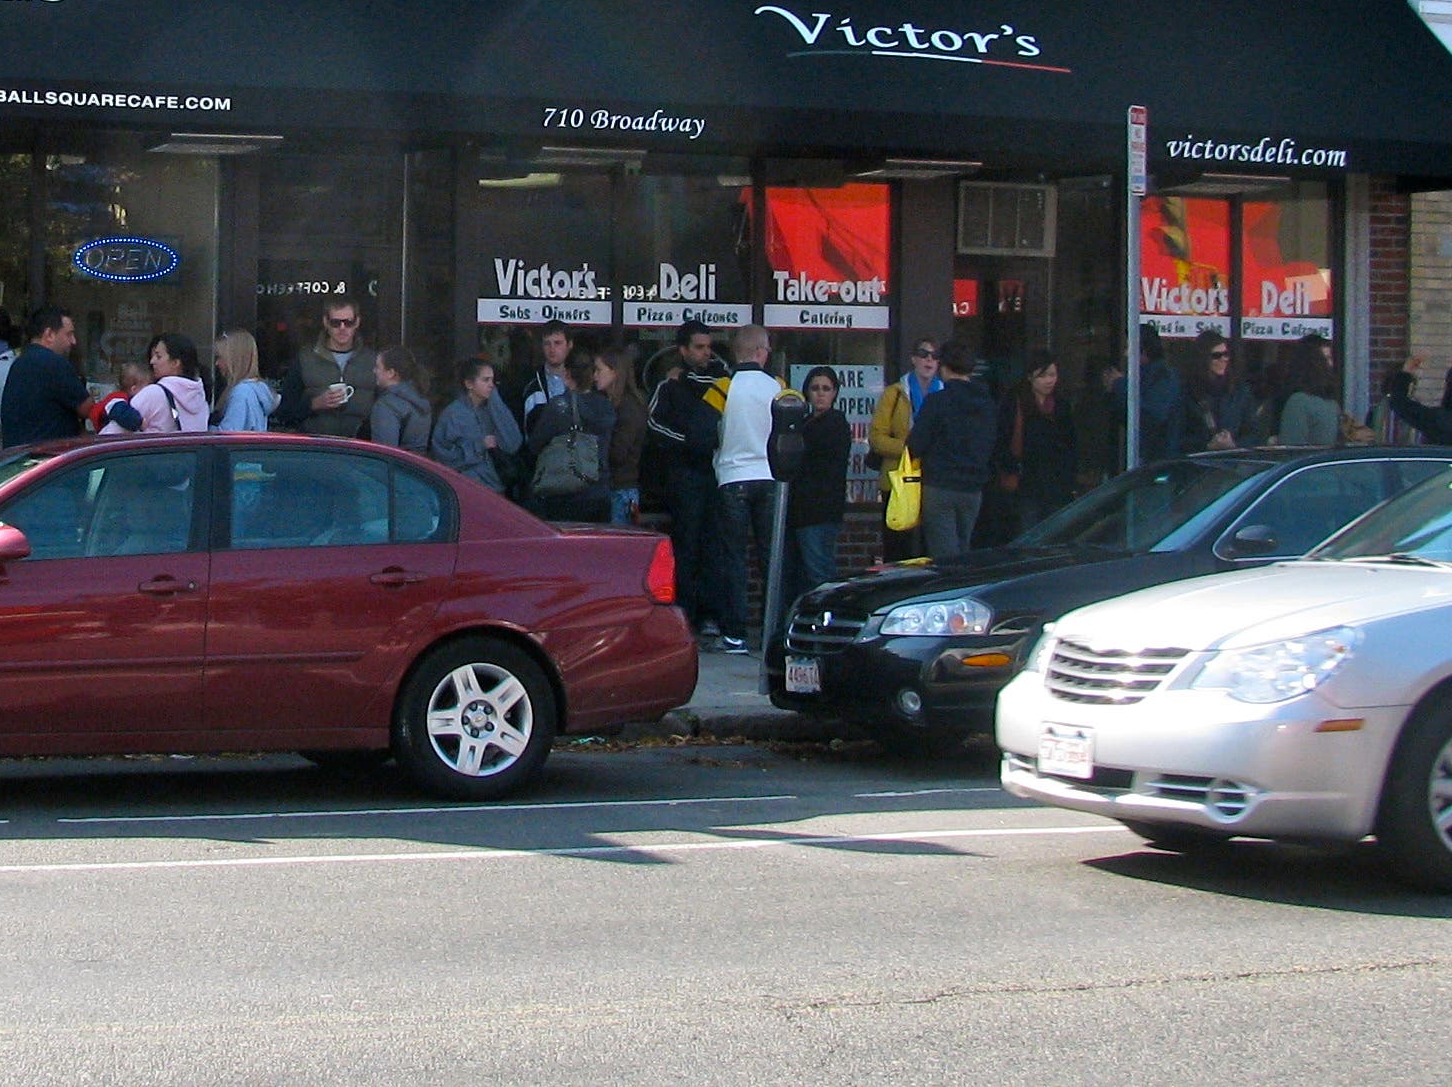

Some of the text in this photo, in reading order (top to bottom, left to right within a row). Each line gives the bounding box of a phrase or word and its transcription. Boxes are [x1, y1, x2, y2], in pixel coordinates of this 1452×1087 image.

[754, 5, 1041, 57] Victor's
[543, 107, 705, 140] 710 Broadway
[1166, 134, 1348, 167] victorsdeli.com
[85, 248, 162, 271] OPEN
[494, 258, 598, 299] Victor's
[660, 263, 717, 300] Deli
[1141, 277, 1312, 315] Victor's Deli
[499, 304, 591, 321] Subs Dinners
[636, 308, 739, 324] Pizza Calzones
[799, 310, 853, 328] Catering
[1242, 321, 1273, 336] Pizza
[837, 369, 865, 388] ARE
[838, 397, 875, 415] OPEN
